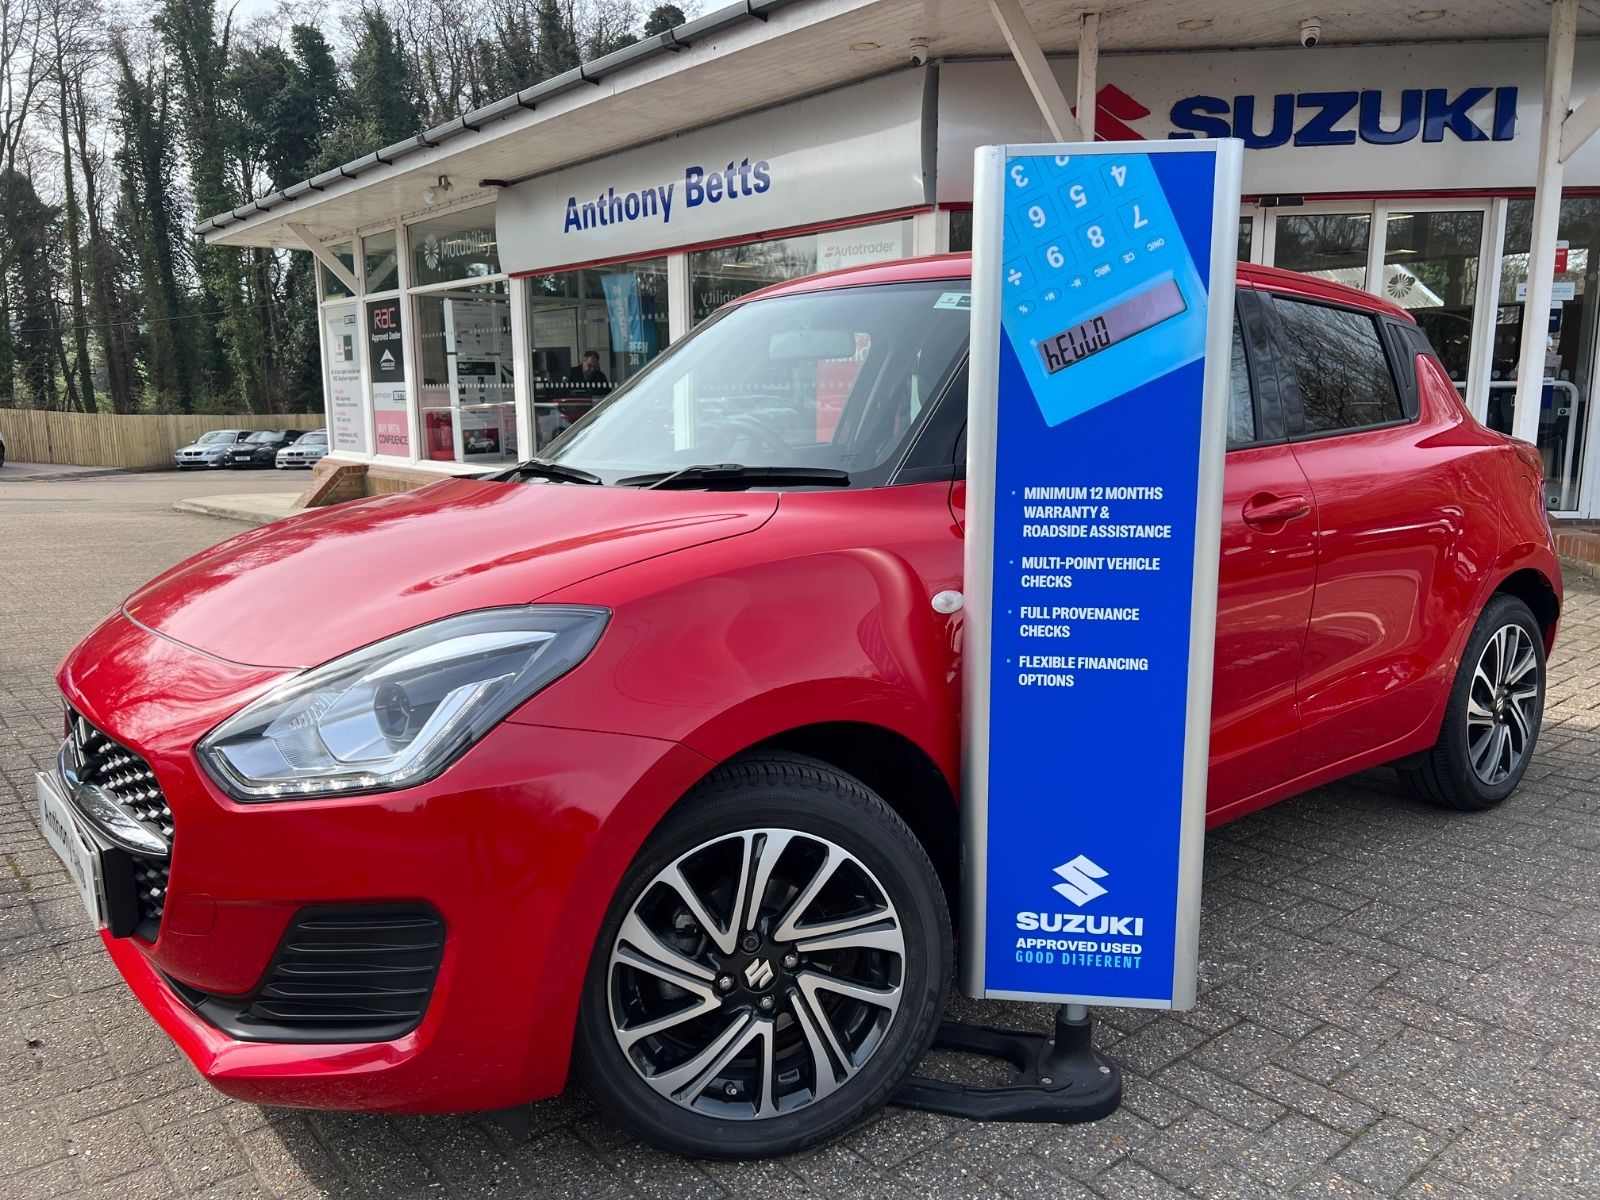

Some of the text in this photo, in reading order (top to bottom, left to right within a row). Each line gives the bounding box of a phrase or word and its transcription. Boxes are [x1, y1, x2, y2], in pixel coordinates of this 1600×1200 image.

[1168, 86, 1519, 148] SUZUKI
[1010, 165, 1028, 188] 3
[1110, 166, 1126, 187] 4
[564, 157, 771, 233] Anthony Betts
[1069, 185, 1087, 208] 5
[1028, 206, 1046, 228] 6
[1133, 205, 1148, 229] 7
[441, 229, 492, 260] Motability
[1087, 225, 1105, 248] 8
[834, 241, 894, 257] Autotrader
[1046, 246, 1065, 269] 9
[1123, 252, 1136, 263] CE
[1024, 487, 1163, 500] MINIMUM 12 MONTHS
[1023, 505, 1110, 519] WARRANTY &
[1023, 525, 1171, 538] ROADSIDE ASSISTANCE
[1022, 556, 1160, 571] MULTI-POINT VEHICLE
[1021, 575, 1072, 588] CHECKS
[1020, 606, 1140, 621] FULL PROVENANCE
[1019, 625, 1071, 638] CHECKS
[1019, 655, 1149, 671] FLEXIBLE FINANCING
[1018, 673, 1075, 687] OPTIONS
[1016, 911, 1144, 936] SUZUKI
[1016, 937, 1142, 955] APPROVED USED
[1015, 950, 1141, 969] GOOD DIFFERENT
